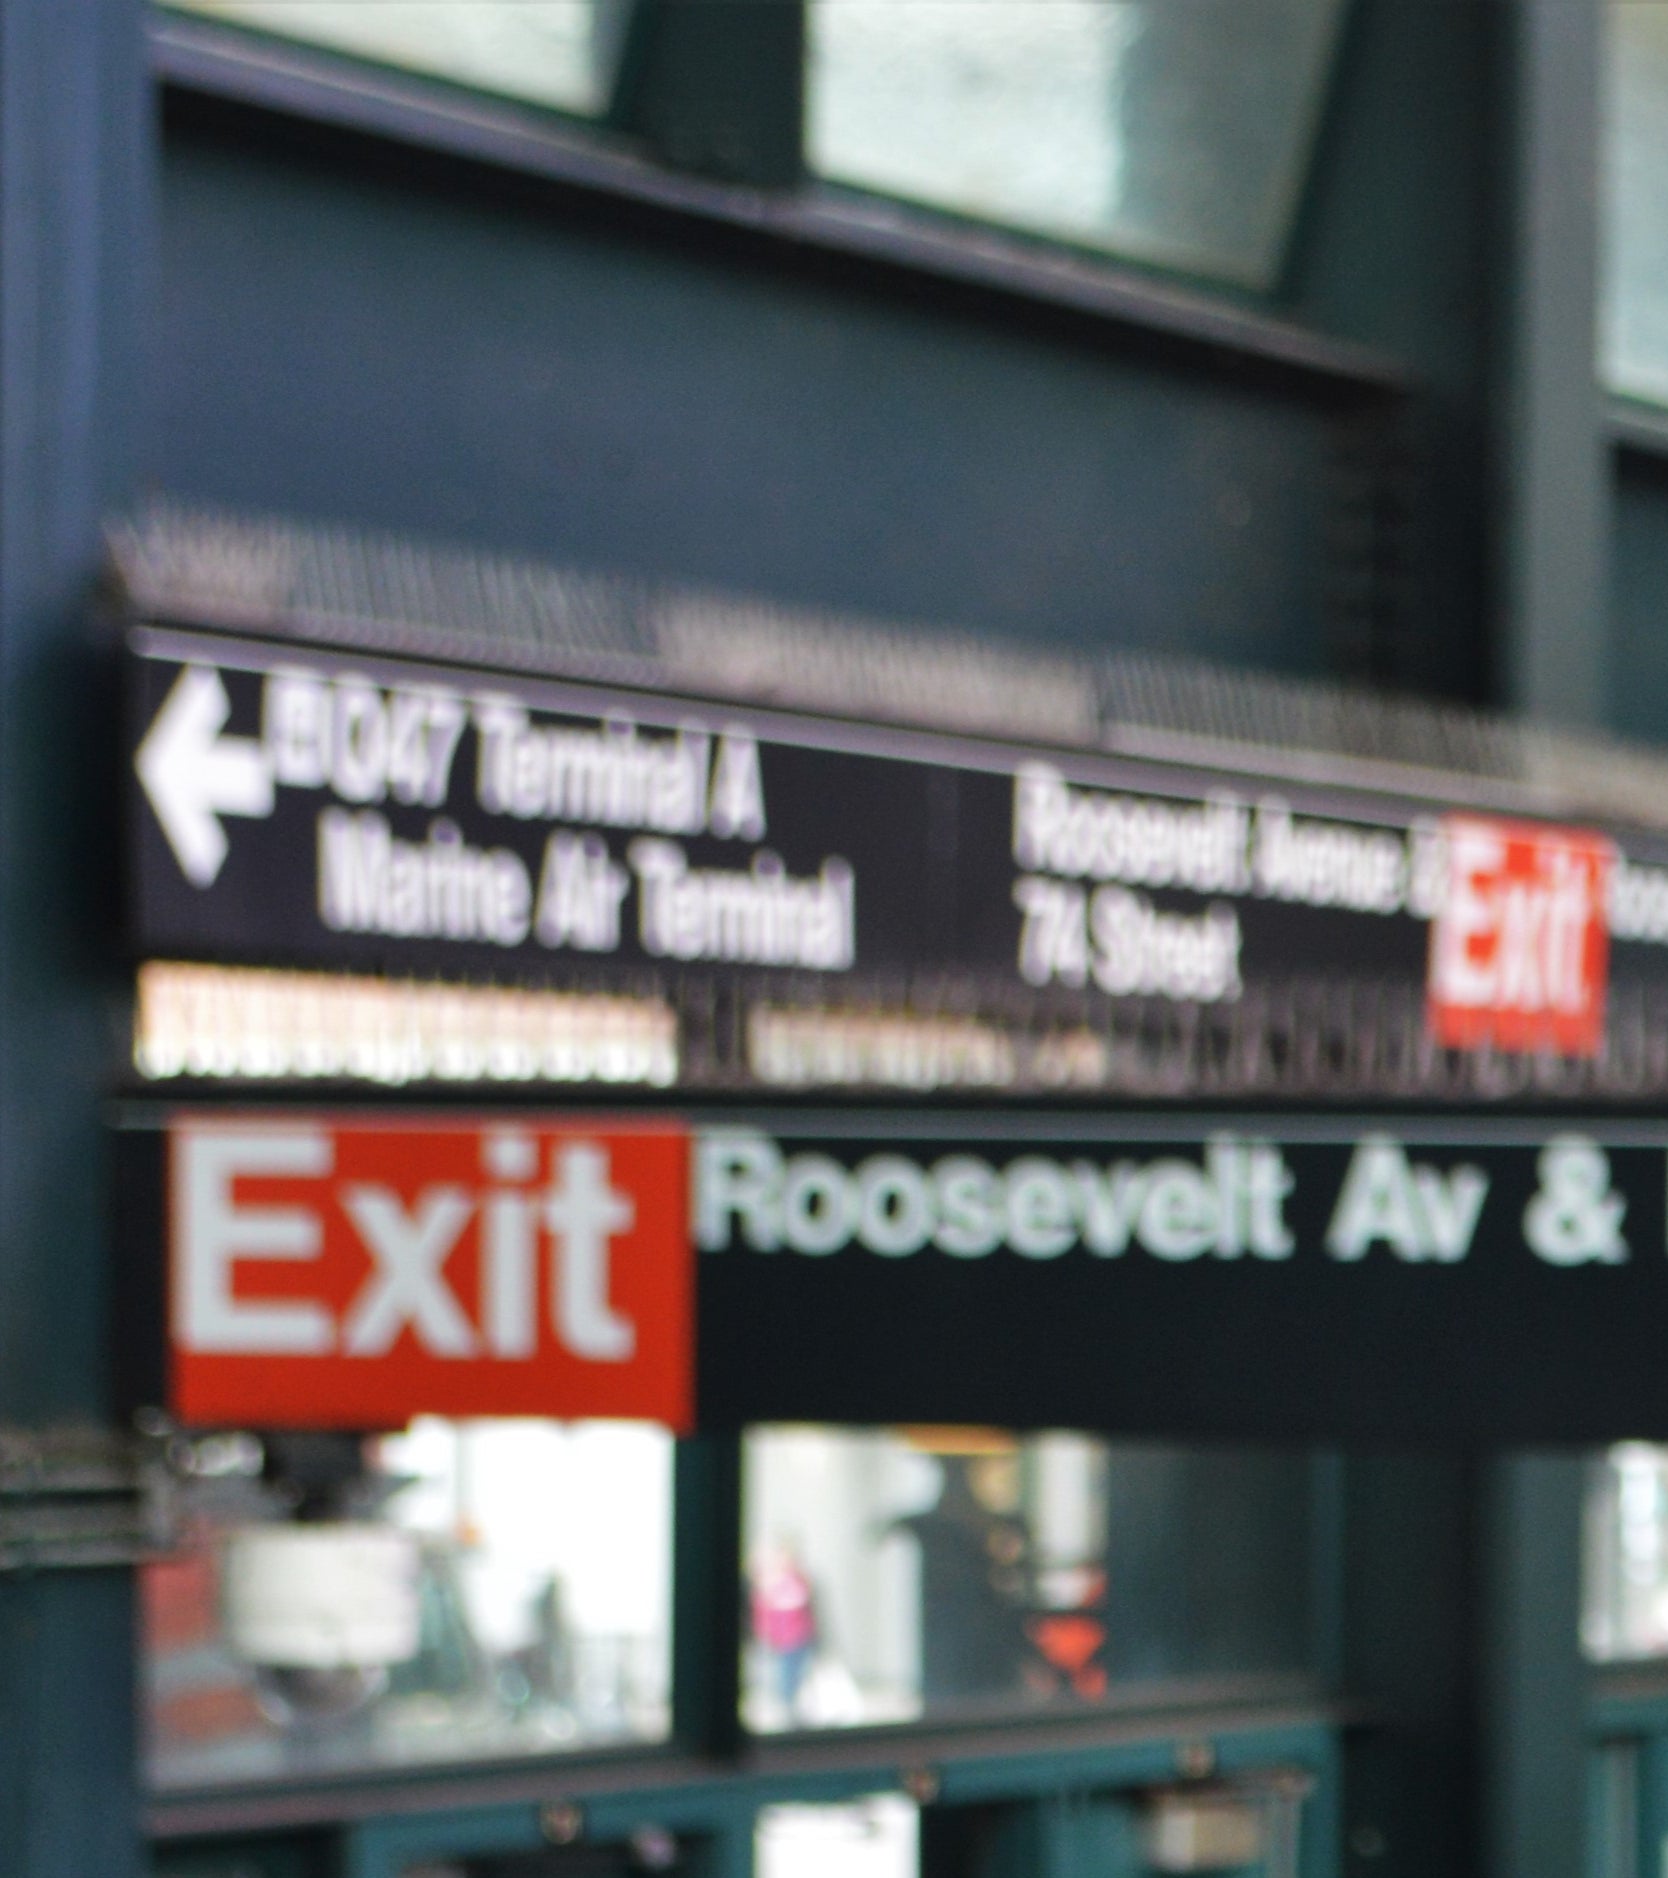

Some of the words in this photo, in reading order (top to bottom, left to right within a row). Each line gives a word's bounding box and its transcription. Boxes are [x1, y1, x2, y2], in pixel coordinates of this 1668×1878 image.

[329, 671, 466, 806] Q47
[474, 692, 709, 836] Terminal
[711, 724, 766, 843] A
[1013, 760, 1251, 895] Roosevelt
[316, 807, 531, 948] Marine
[535, 829, 628, 952] Air
[628, 839, 855, 972] Terminal
[1092, 882, 1243, 1002] Street
[1431, 815, 1597, 1013] Exit
[173, 1119, 636, 1362] Exit
[691, 1124, 1296, 1262] Roosevelt
[1326, 1132, 1489, 1264] Av
[1522, 1132, 1630, 1269] &
